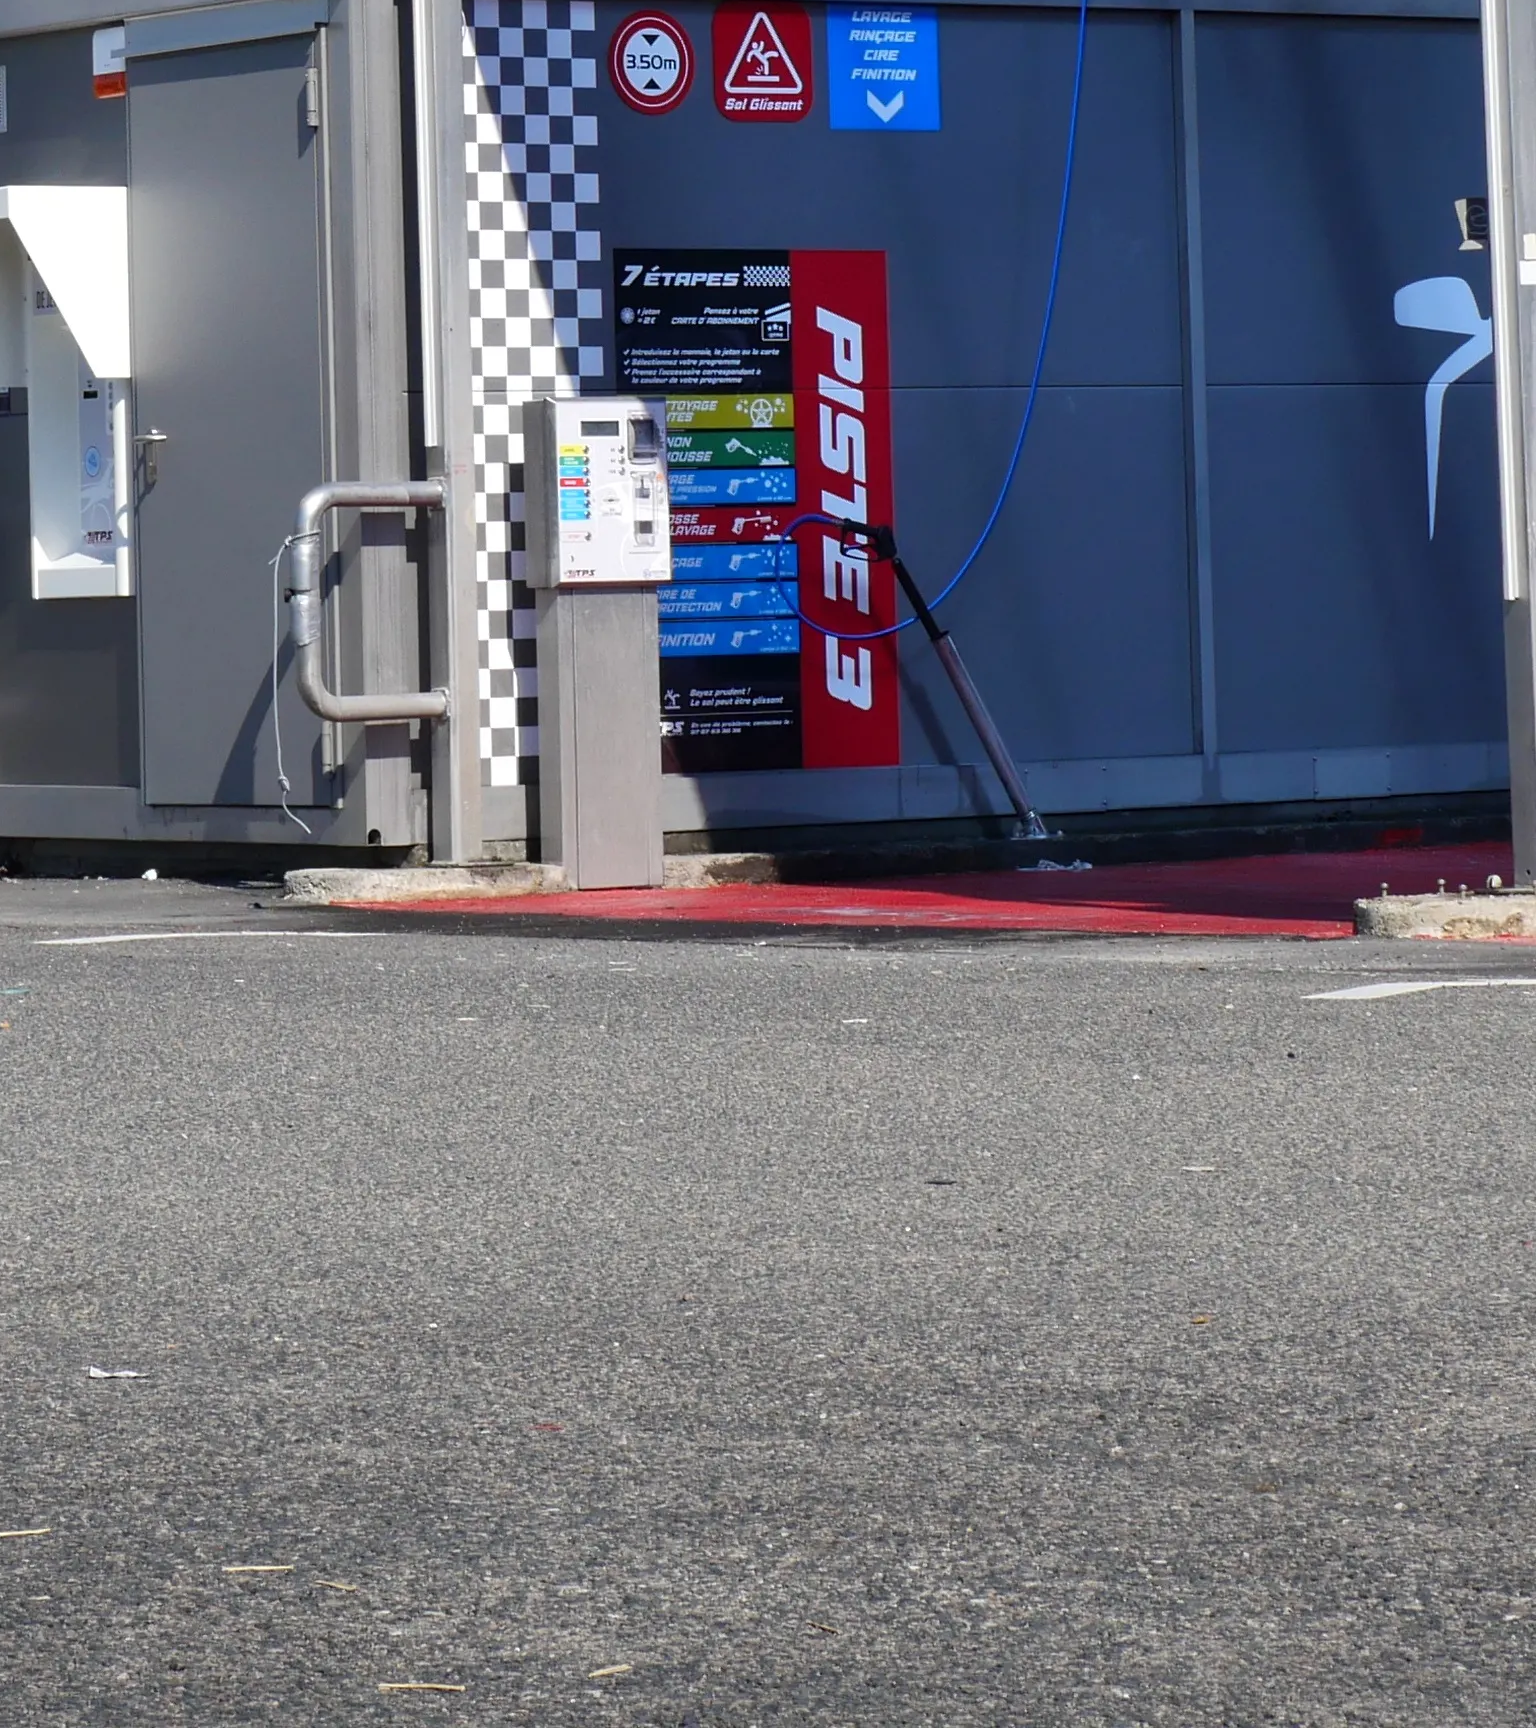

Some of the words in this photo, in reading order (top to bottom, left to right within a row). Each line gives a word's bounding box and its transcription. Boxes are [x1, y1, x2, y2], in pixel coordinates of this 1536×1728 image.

[852, 11, 912, 23] LAVAGE
[849, 30, 916, 45] RINÇAGE
[626, 53, 677, 70] 3.50m
[864, 50, 900, 61] CIRE
[850, 68, 917, 81] FINITION
[725, 97, 746, 111] Sol
[750, 97, 803, 111] Glissant
[621, 265, 643, 286] 7
[644, 265, 740, 287] ÉTAPES
[816, 306, 870, 615] PISTE
[824, 632, 873, 711] 3
